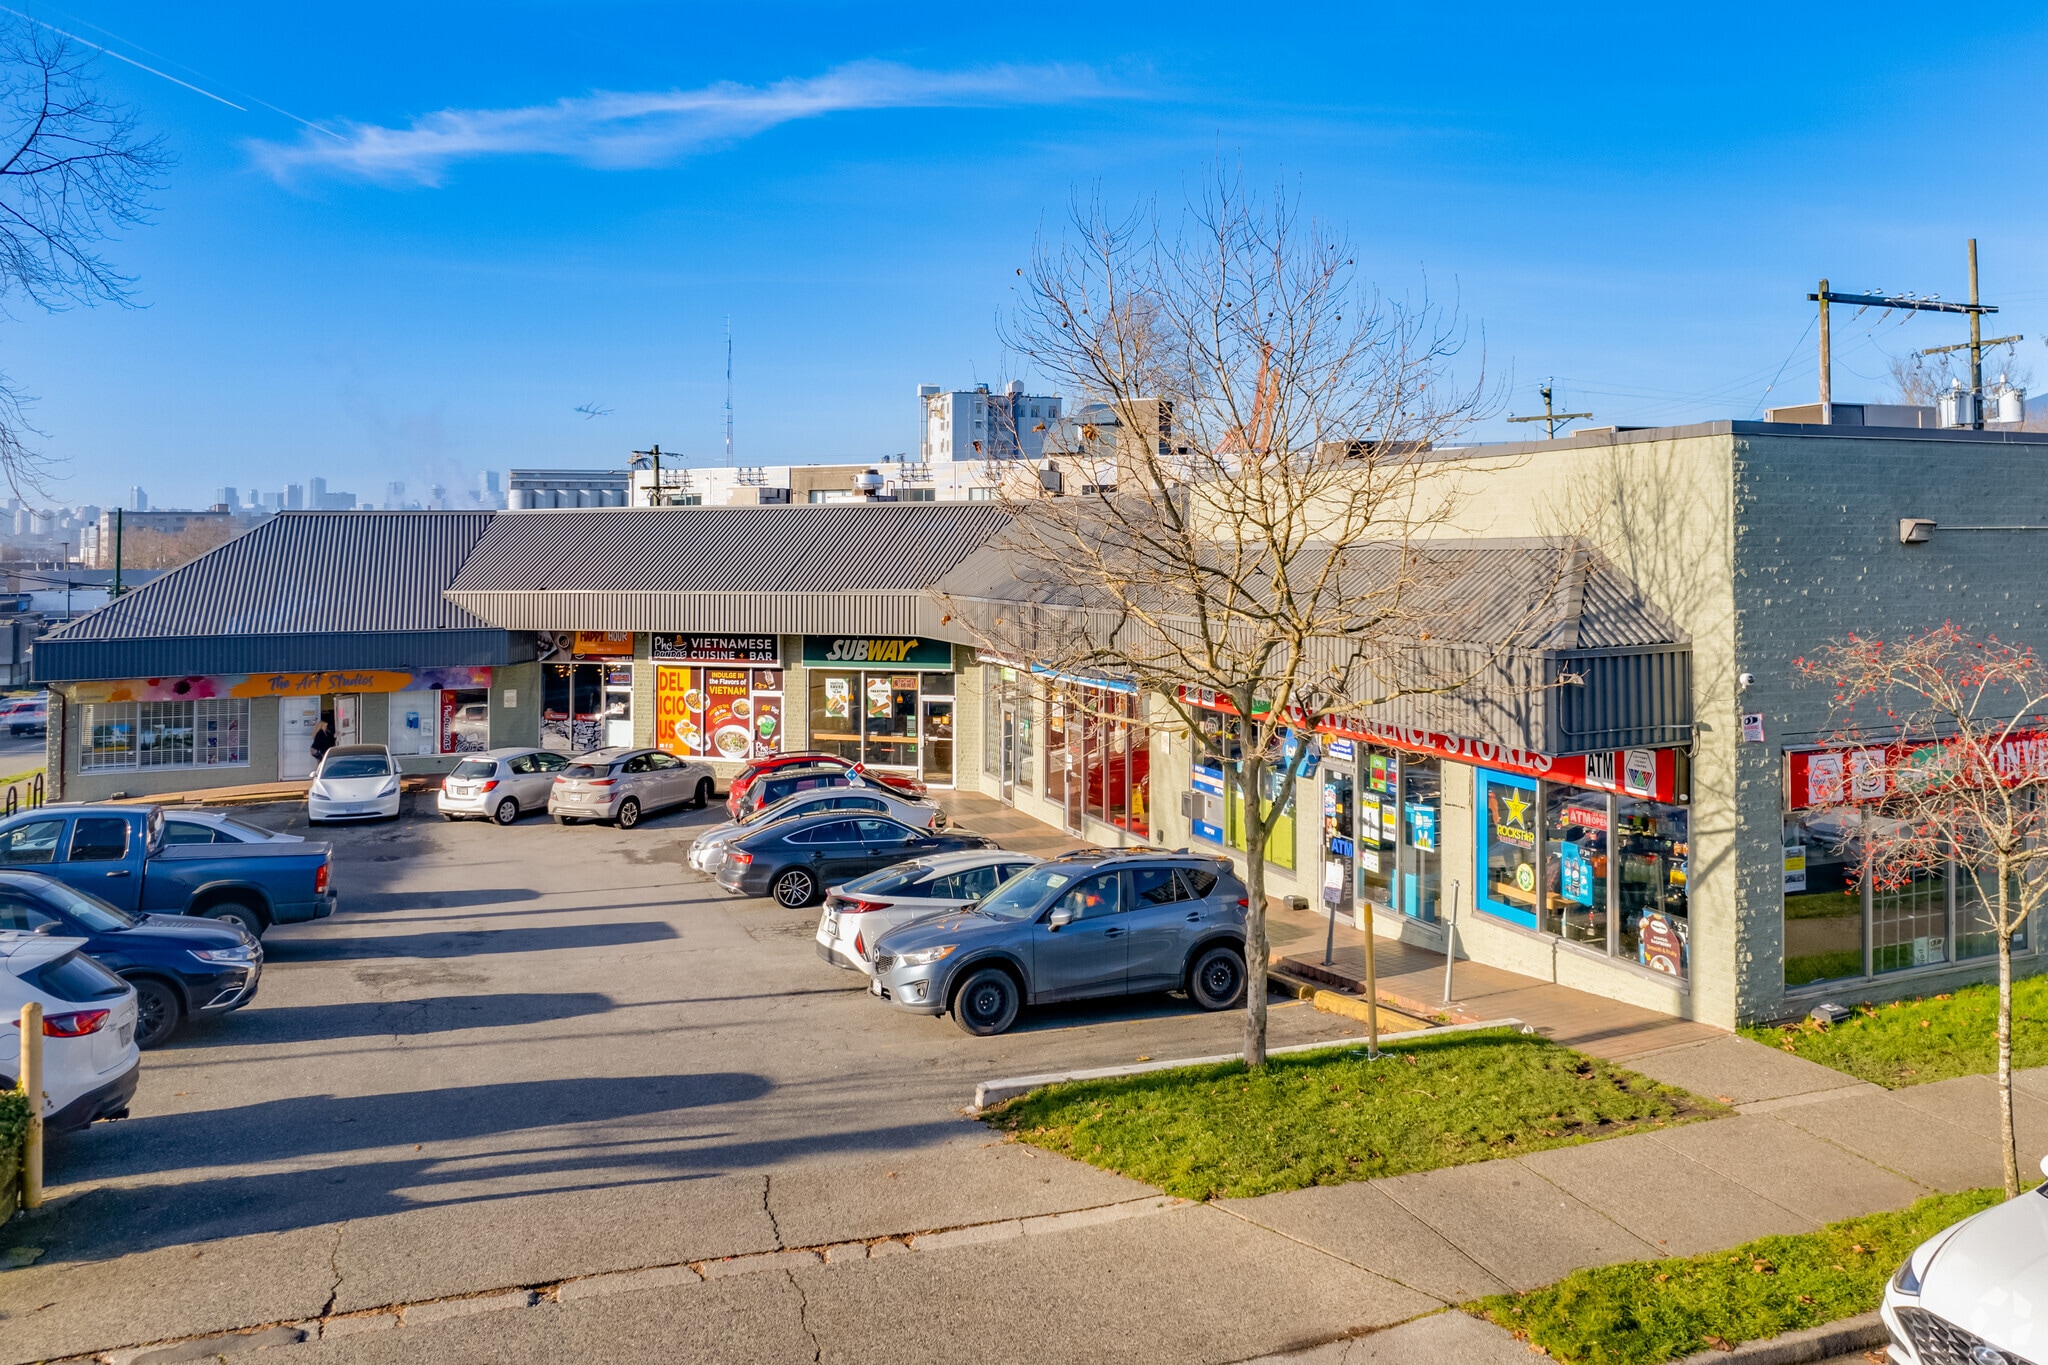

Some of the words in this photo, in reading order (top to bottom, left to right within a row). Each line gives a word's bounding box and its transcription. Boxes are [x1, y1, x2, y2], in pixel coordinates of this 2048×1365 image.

[690, 637, 772, 650] VIETNAMESE
[826, 639, 919, 661] SUBWAY
[690, 650, 735, 660] CUISINE
[749, 651, 772, 661] BAR
[268, 675, 291, 691] The
[296, 674, 322, 691] Art
[328, 674, 374, 690] Studios
[660, 672, 685, 691] DEL
[709, 686, 746, 695] VIETNAM
[893, 678, 917, 688] OPEN
[660, 695, 686, 715] ICIO
[660, 719, 676, 739] US
[1587, 752, 1613, 780] ATM
[1570, 811, 1591, 825] ATM
[1331, 838, 1353, 857] ATM
